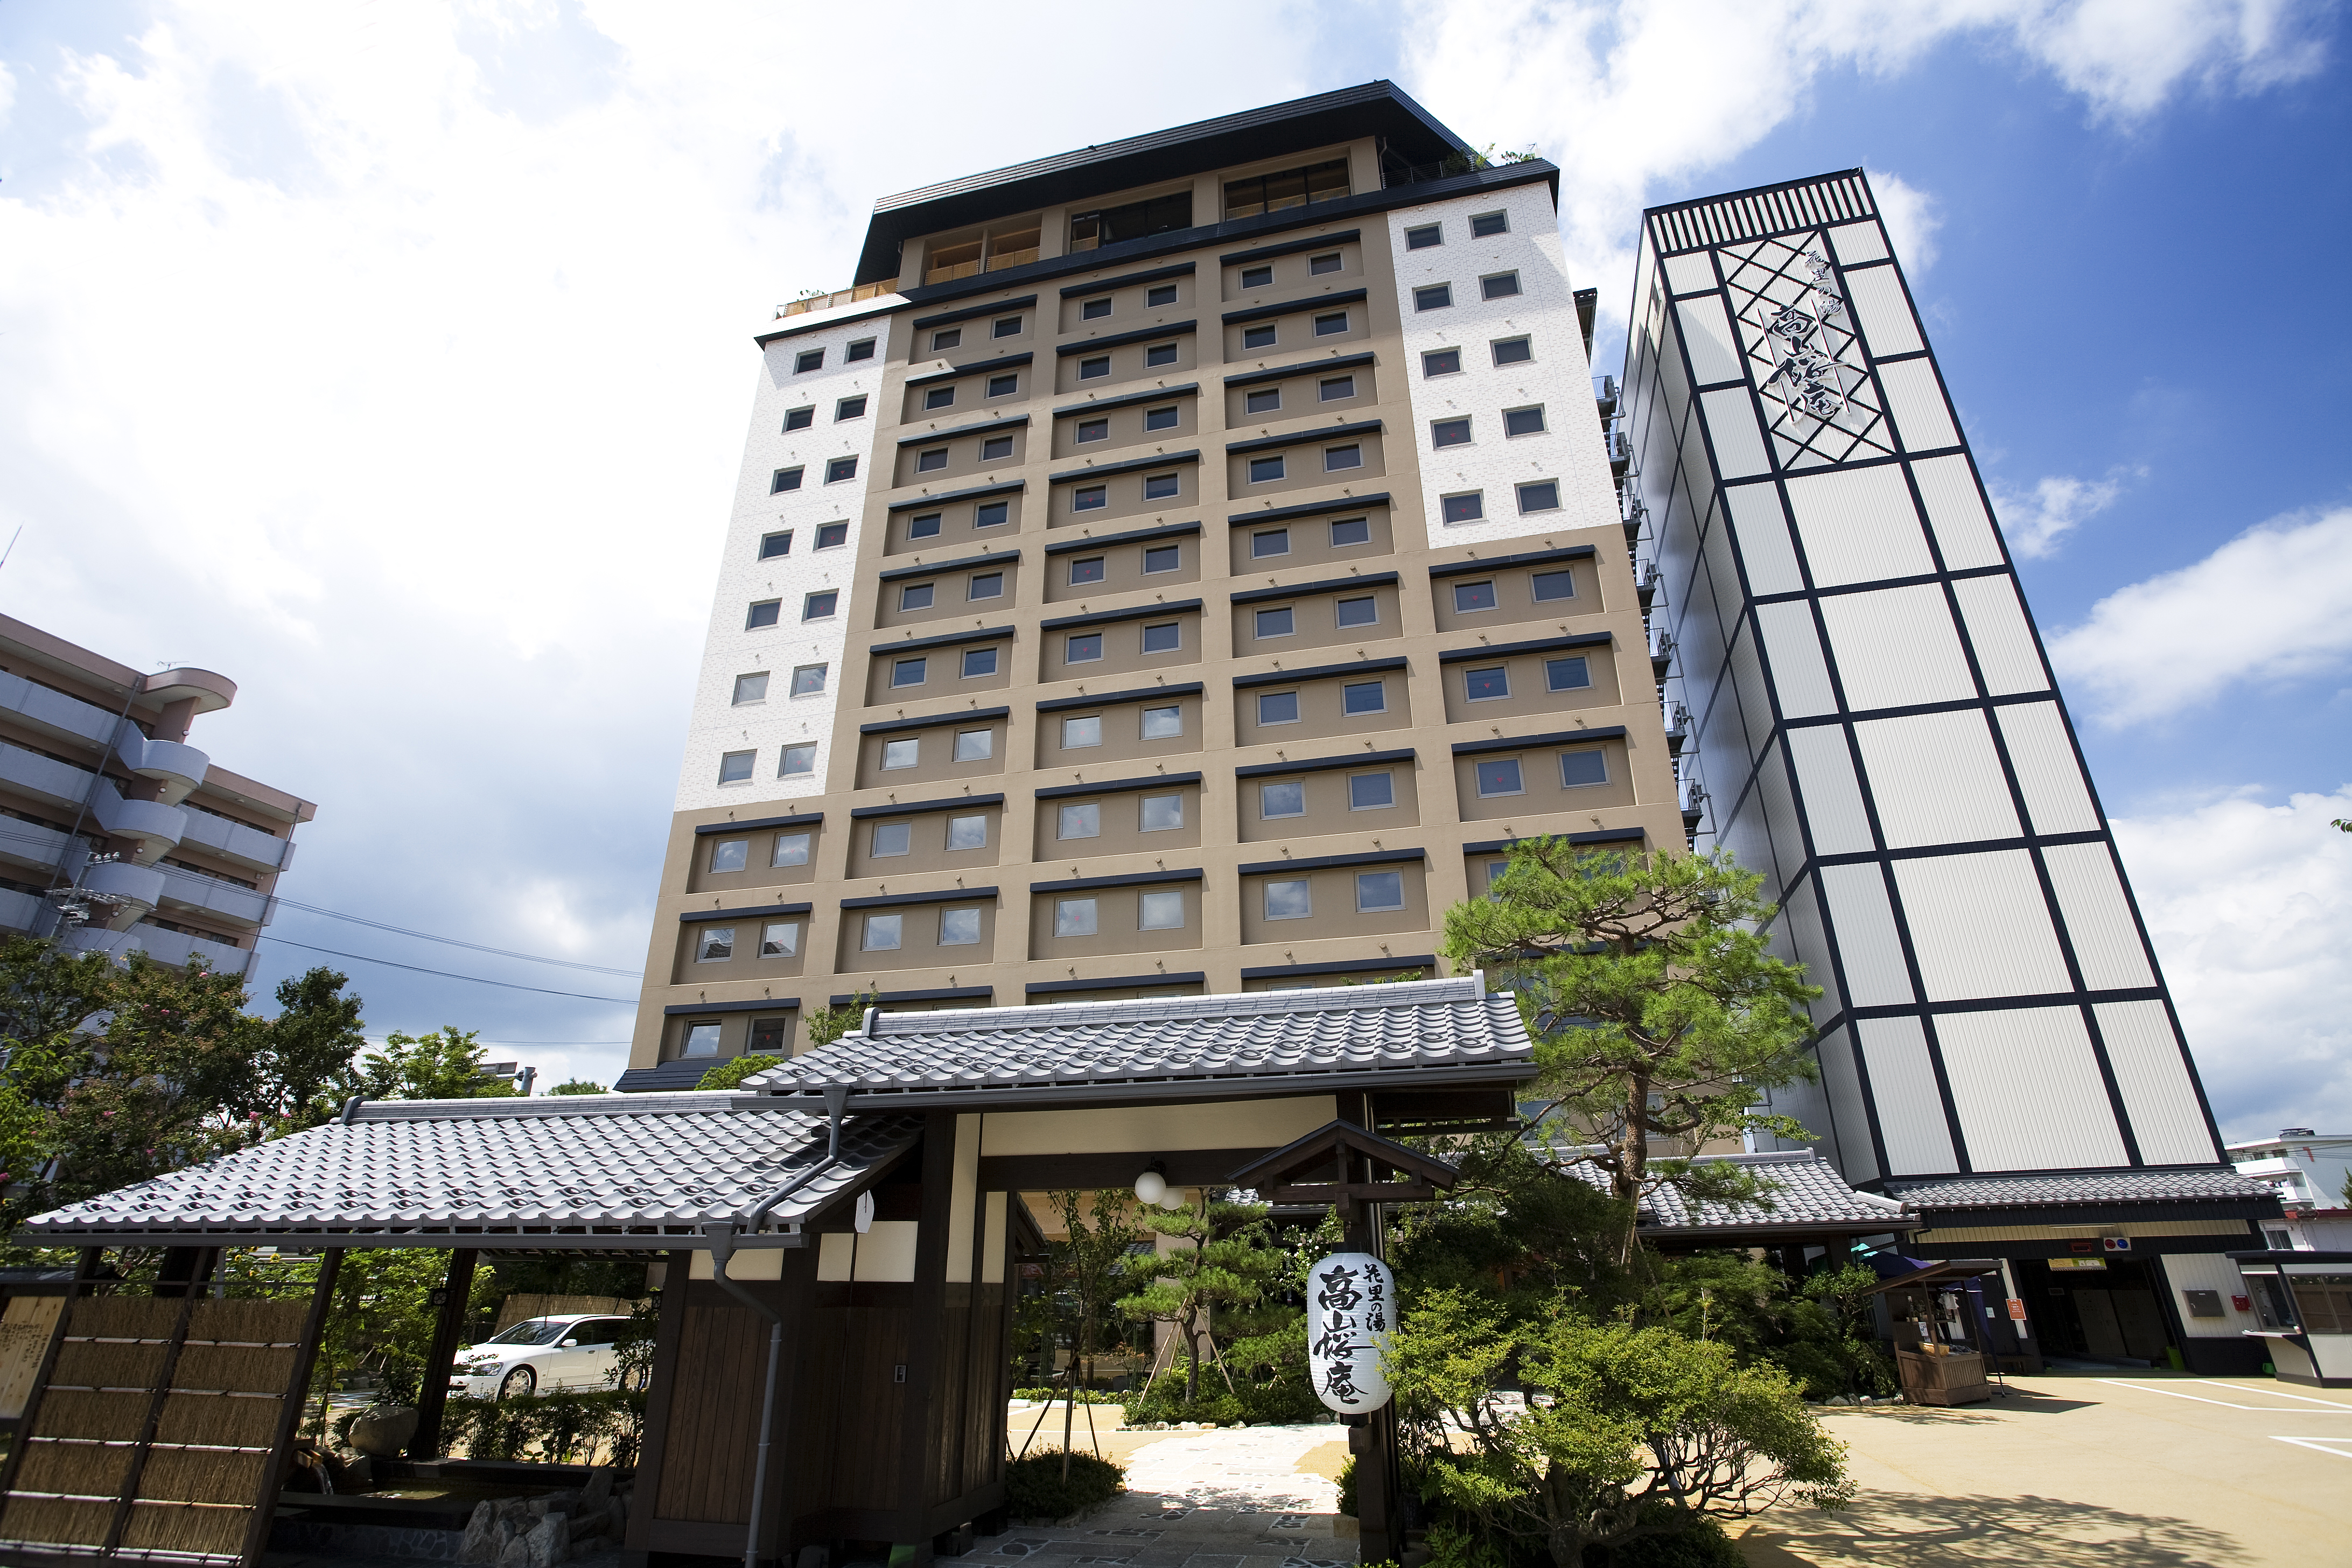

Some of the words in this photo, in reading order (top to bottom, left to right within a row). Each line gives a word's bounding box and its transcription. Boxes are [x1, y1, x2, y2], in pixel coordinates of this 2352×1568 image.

[1804, 250, 1842, 316] 花里の湯
[1767, 304, 1851, 424] 高山桜庵
[1313, 1264, 1376, 1404] 高山桜庵
[1363, 1263, 1386, 1333] 花里の湯
